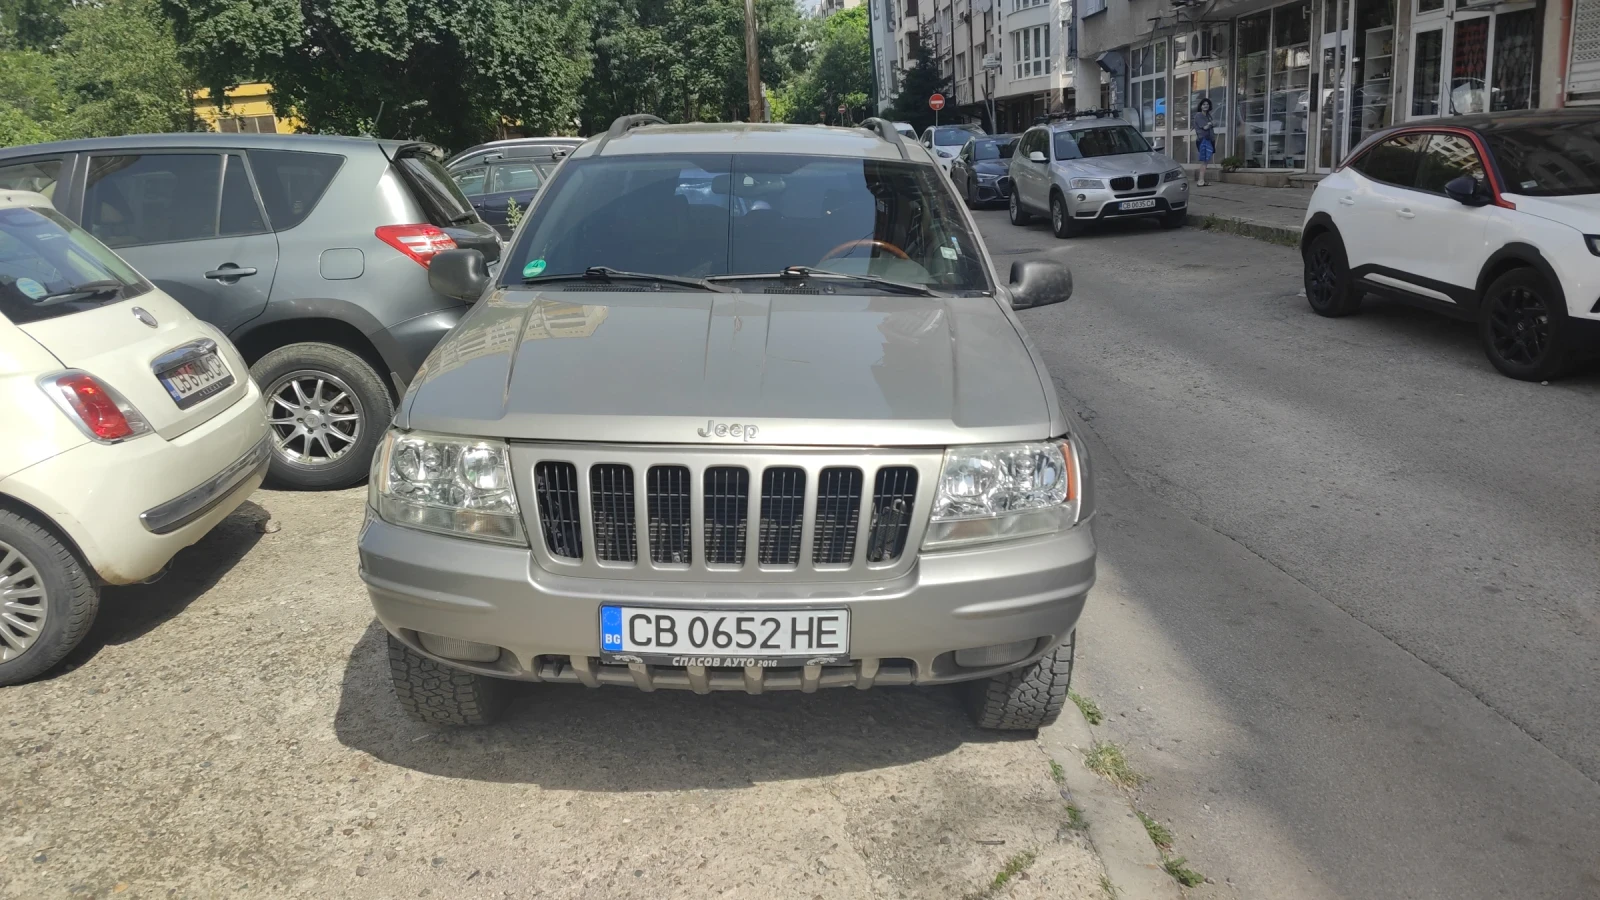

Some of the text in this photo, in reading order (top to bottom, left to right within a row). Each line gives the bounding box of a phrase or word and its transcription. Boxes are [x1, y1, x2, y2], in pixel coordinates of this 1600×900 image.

[697, 419, 759, 442] Jeep
[605, 633, 621, 644] BG
[629, 613, 839, 649] CB 0652 HE
[672, 656, 720, 667] СПАСОВ
[757, 659, 778, 668] 2016
